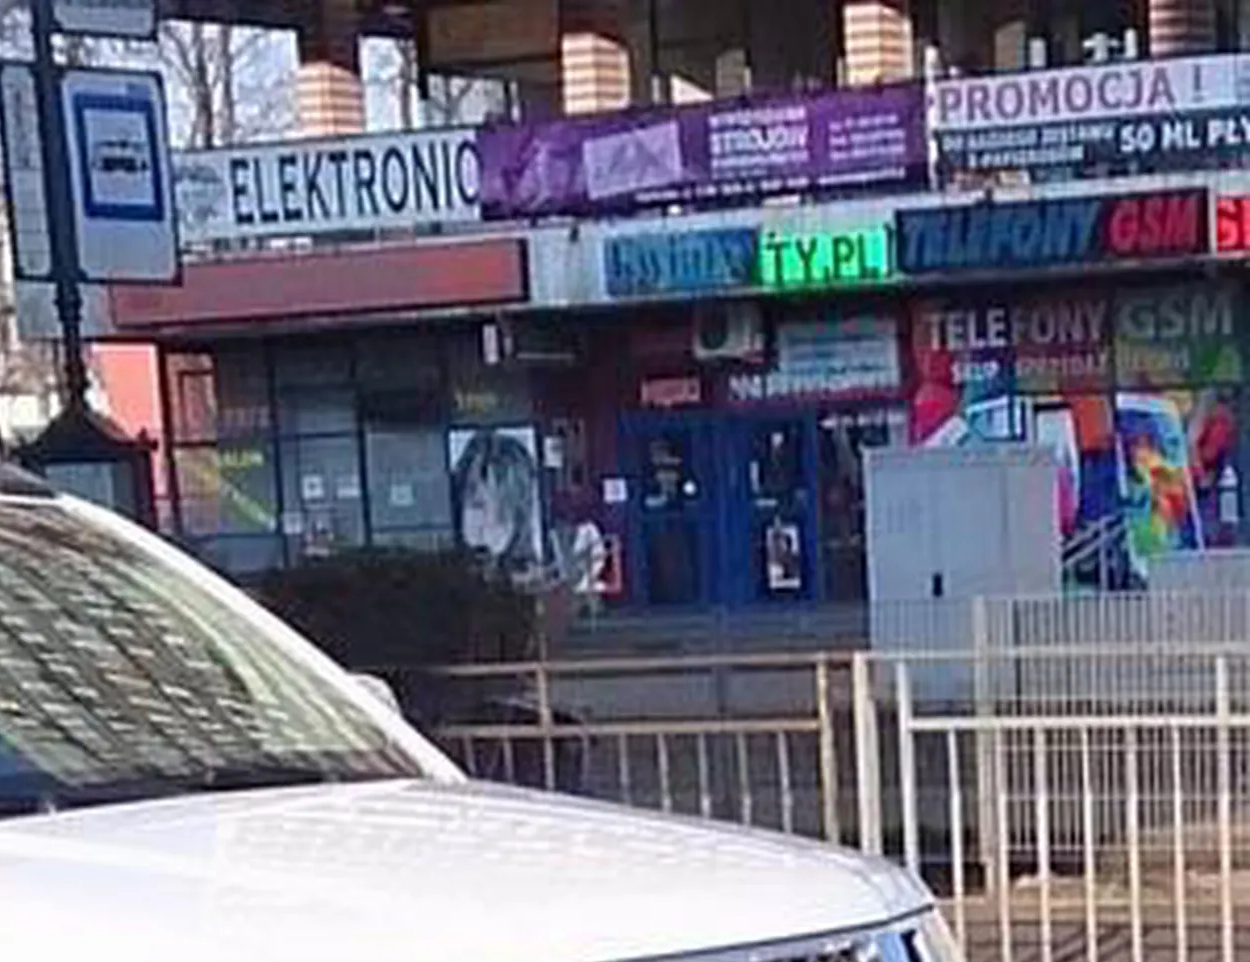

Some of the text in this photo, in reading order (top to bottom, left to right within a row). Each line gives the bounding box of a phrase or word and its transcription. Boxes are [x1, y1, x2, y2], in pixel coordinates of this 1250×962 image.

[940, 66, 1175, 122] PROMOCJA
[1120, 123, 1156, 152] 50
[1161, 120, 1201, 151] ML
[901, 194, 1199, 267] TELEFONY GSM
[922, 294, 1233, 351] TELEFONY GSM
